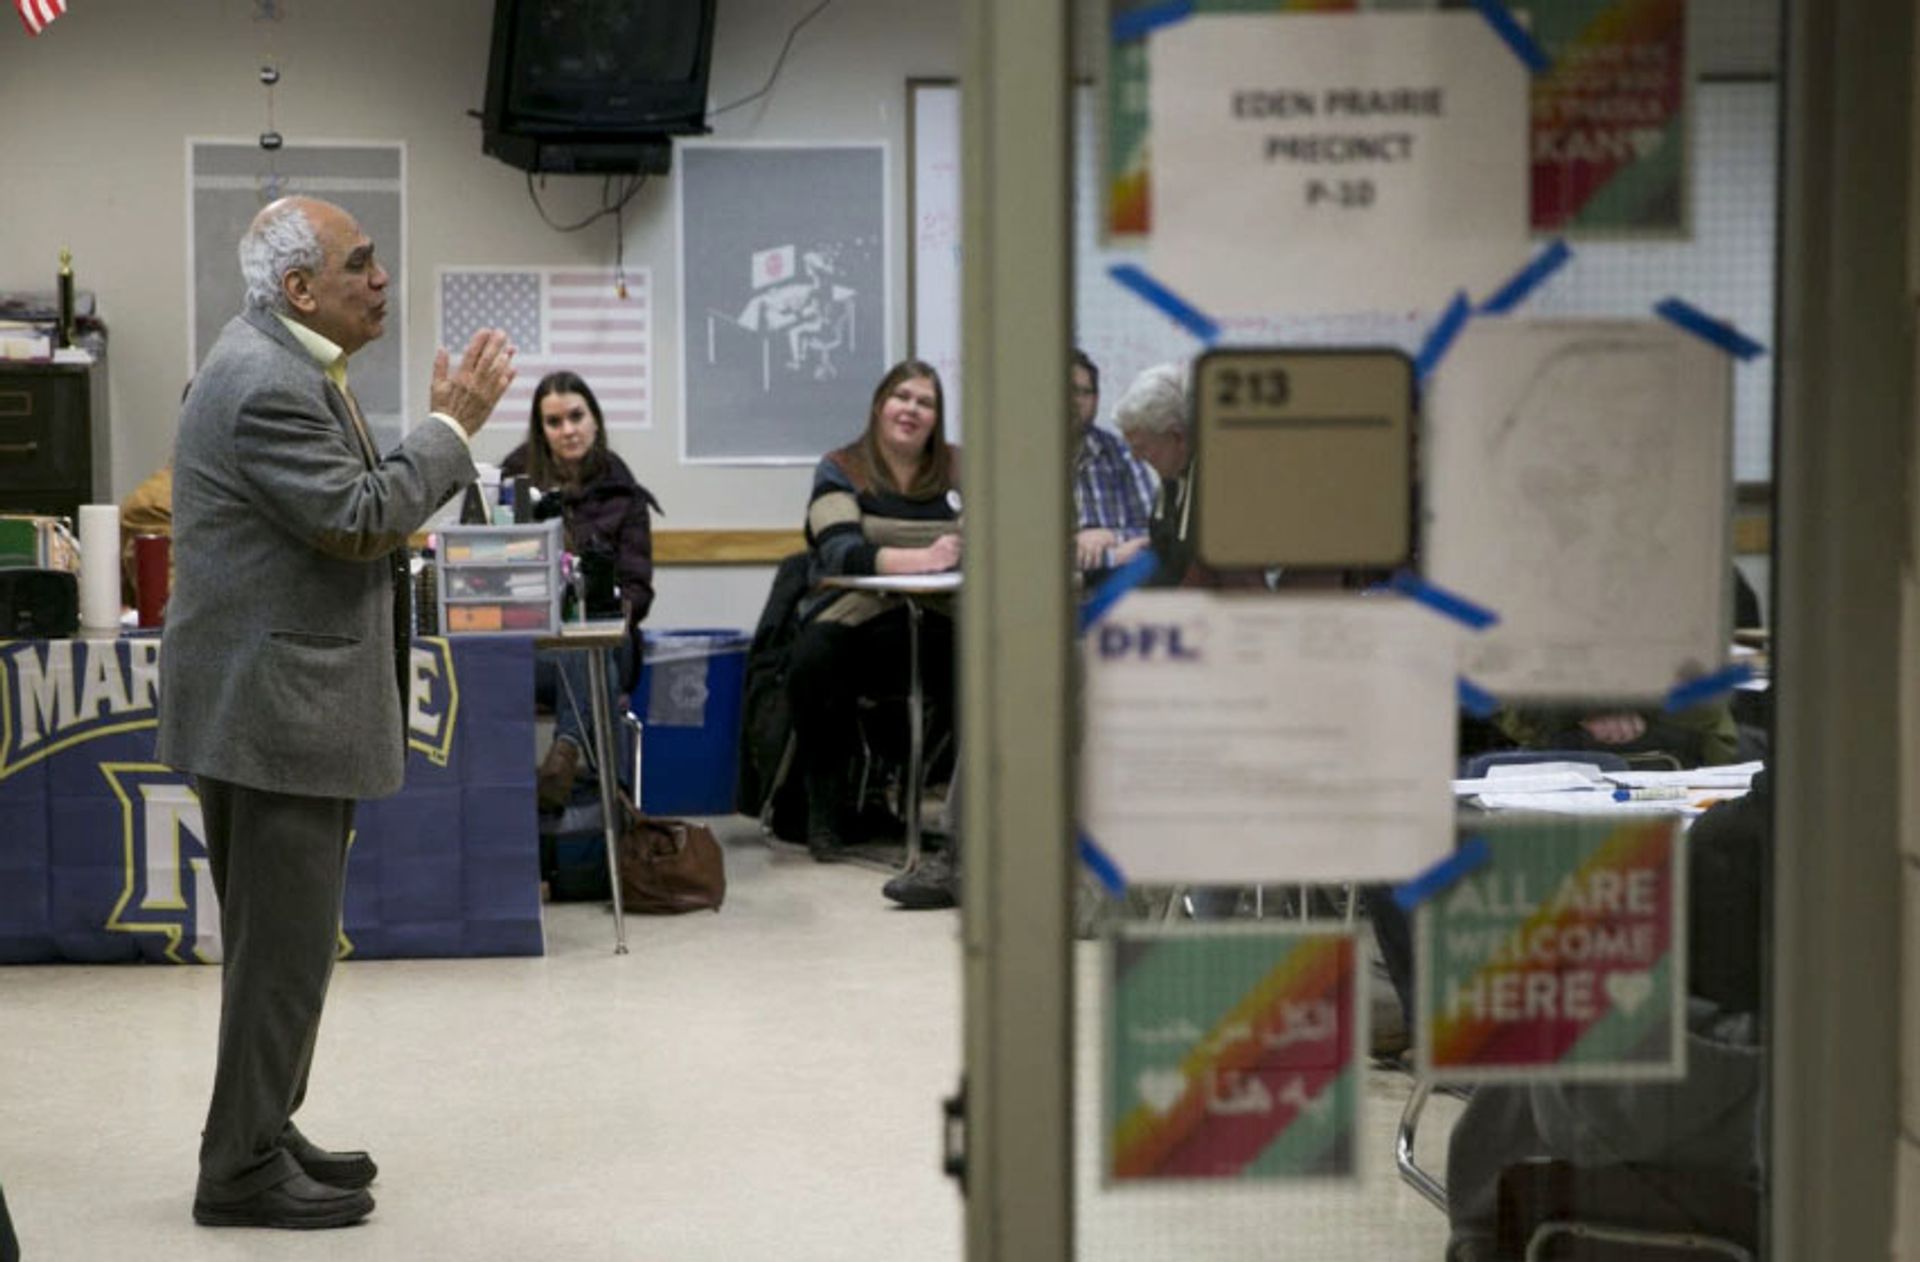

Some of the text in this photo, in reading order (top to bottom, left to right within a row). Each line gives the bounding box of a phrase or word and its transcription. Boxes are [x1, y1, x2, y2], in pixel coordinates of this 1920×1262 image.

[1233, 87, 1446, 119] EDEN PRAIRIE
[1265, 134, 1414, 163] PRECINCT
[1306, 180, 1376, 207] P-10
[1216, 369, 1290, 408] 213
[1098, 623, 1201, 661] DFL
[1446, 868, 1657, 915] ALL ARE
[1446, 924, 1656, 962] WELCOME
[1444, 971, 1597, 1021] HERE
